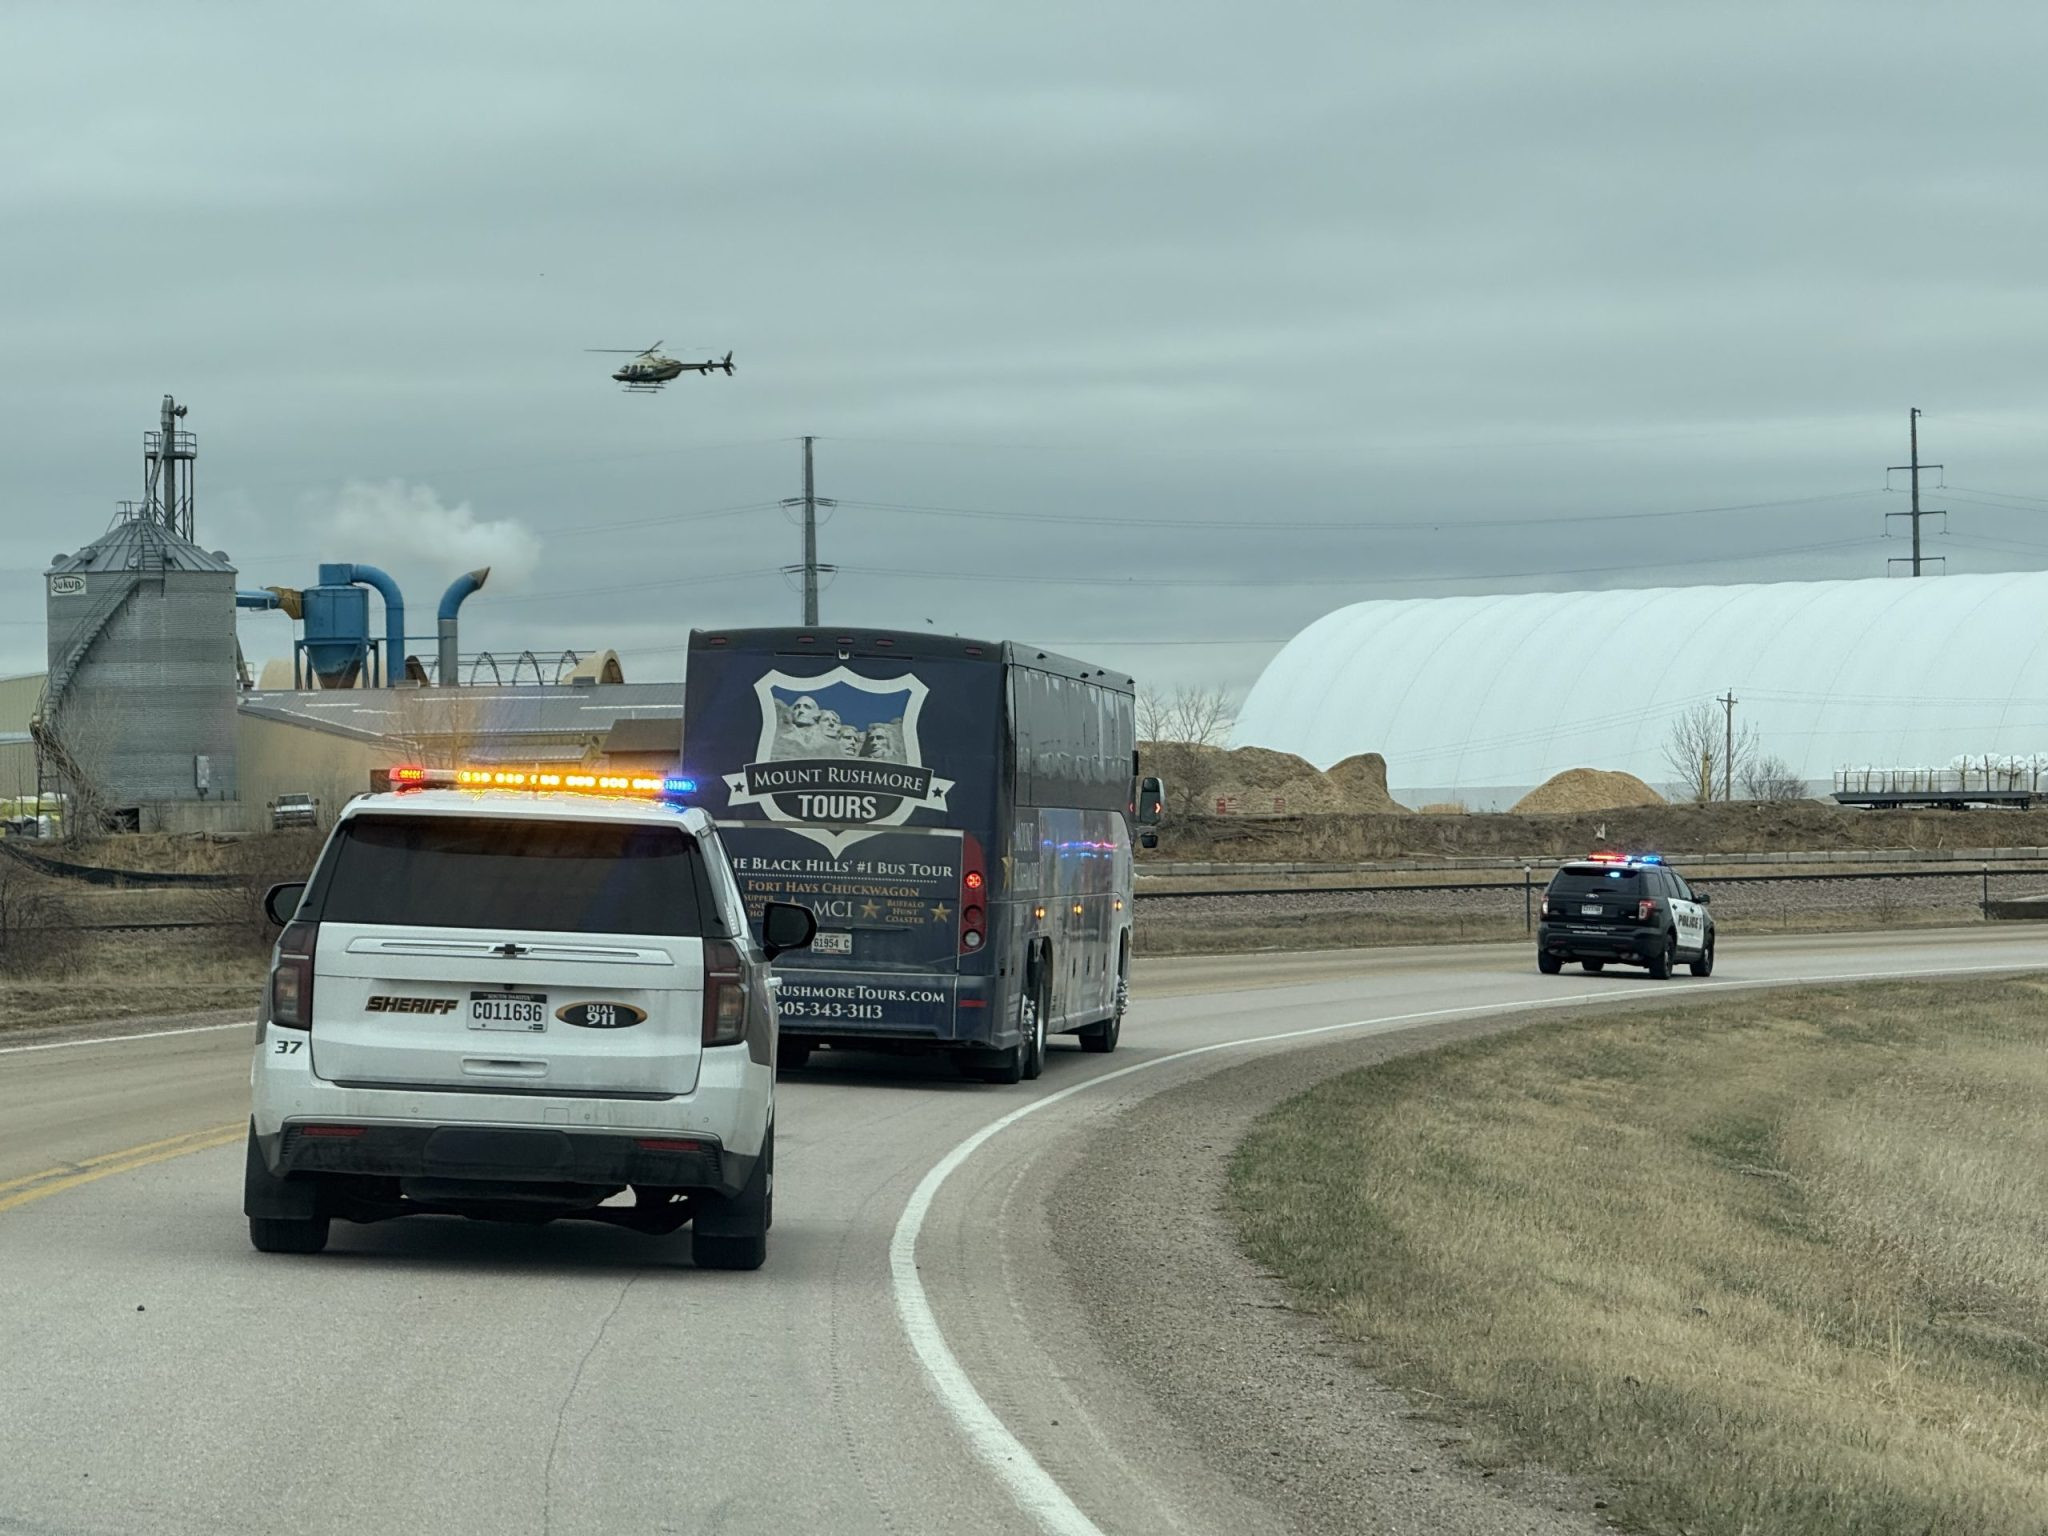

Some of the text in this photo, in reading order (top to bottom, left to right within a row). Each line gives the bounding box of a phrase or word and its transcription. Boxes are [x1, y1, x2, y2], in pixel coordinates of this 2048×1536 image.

[754, 767, 923, 792] MOUNT RUSHMORE
[798, 795, 877, 819] TOURS
[733, 857, 748, 869] HE
[752, 857, 802, 871] BLACK
[857, 860, 873, 874] #1
[878, 862, 906, 876] BUS
[908, 863, 953, 878] TOUR
[747, 880, 920, 897] FORT HAYS CHUCKWAGON
[813, 899, 854, 918] MCI
[1678, 914, 1699, 929] POLICE
[365, 995, 460, 1015] SHERIFF
[587, 1004, 615, 1014] DIAL
[586, 1012, 616, 1025] 911
[275, 1040, 303, 1054] 37
